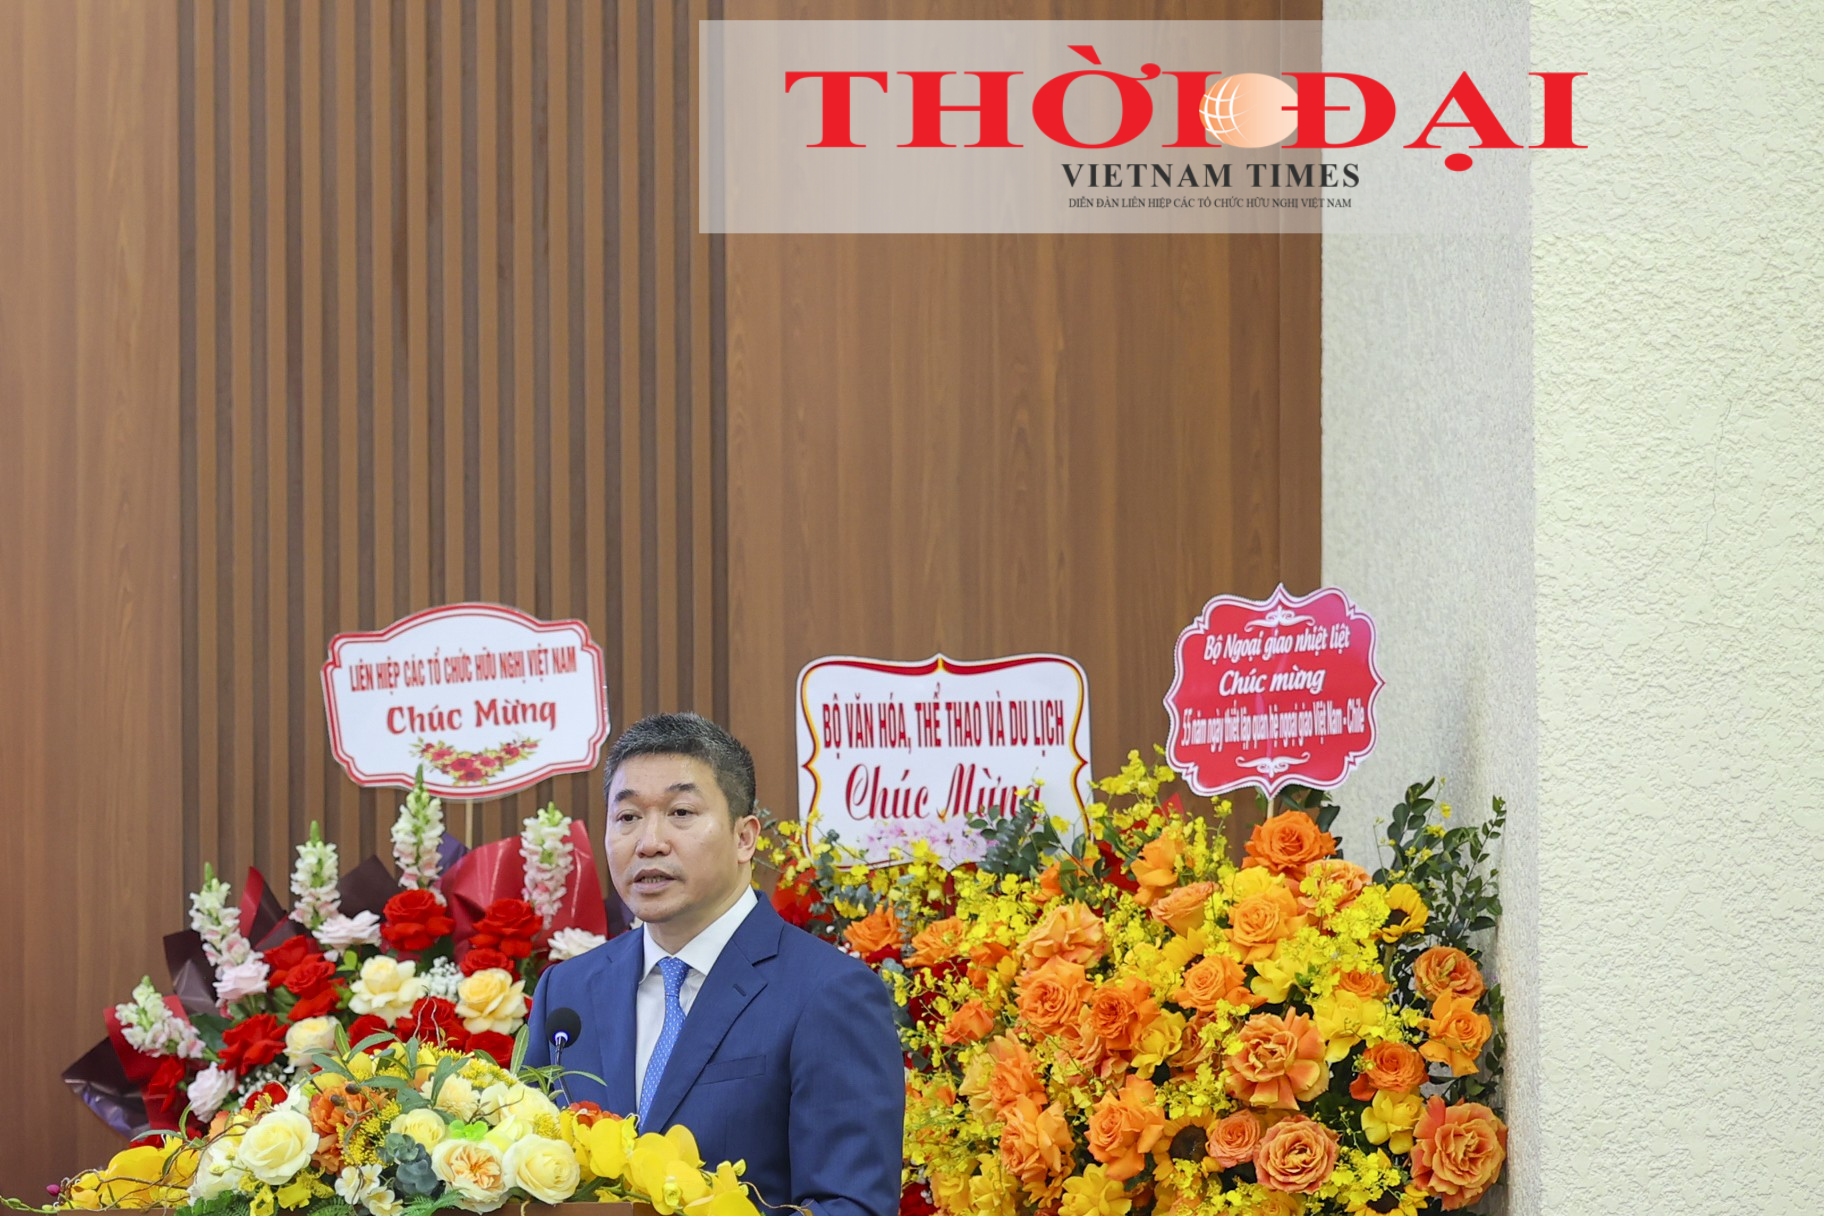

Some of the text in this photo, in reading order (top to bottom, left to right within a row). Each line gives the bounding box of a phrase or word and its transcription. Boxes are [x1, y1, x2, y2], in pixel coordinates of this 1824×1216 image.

[349, 658, 374, 692] LIÊN
[376, 656, 400, 696] HIỆP
[404, 653, 425, 687] CÁC
[527, 643, 549, 682] VIỆT
[552, 646, 577, 675] NAM
[1204, 623, 1350, 665] Bộ Ngoại giao nhiệt liệt
[1219, 664, 1326, 696] Chúc mừng
[387, 698, 557, 735] Chúc Mừng
[822, 681, 1065, 759] BỘ VĂN HÓA, THỂ THAO VÀ DU LỊCH
[1181, 707, 1193, 746] 55
[1252, 713, 1268, 749] quan
[1313, 700, 1327, 745] Việt
[1327, 700, 1343, 735] Nam
[1347, 697, 1365, 734] Chile
[845, 763, 930, 821] Chúc
